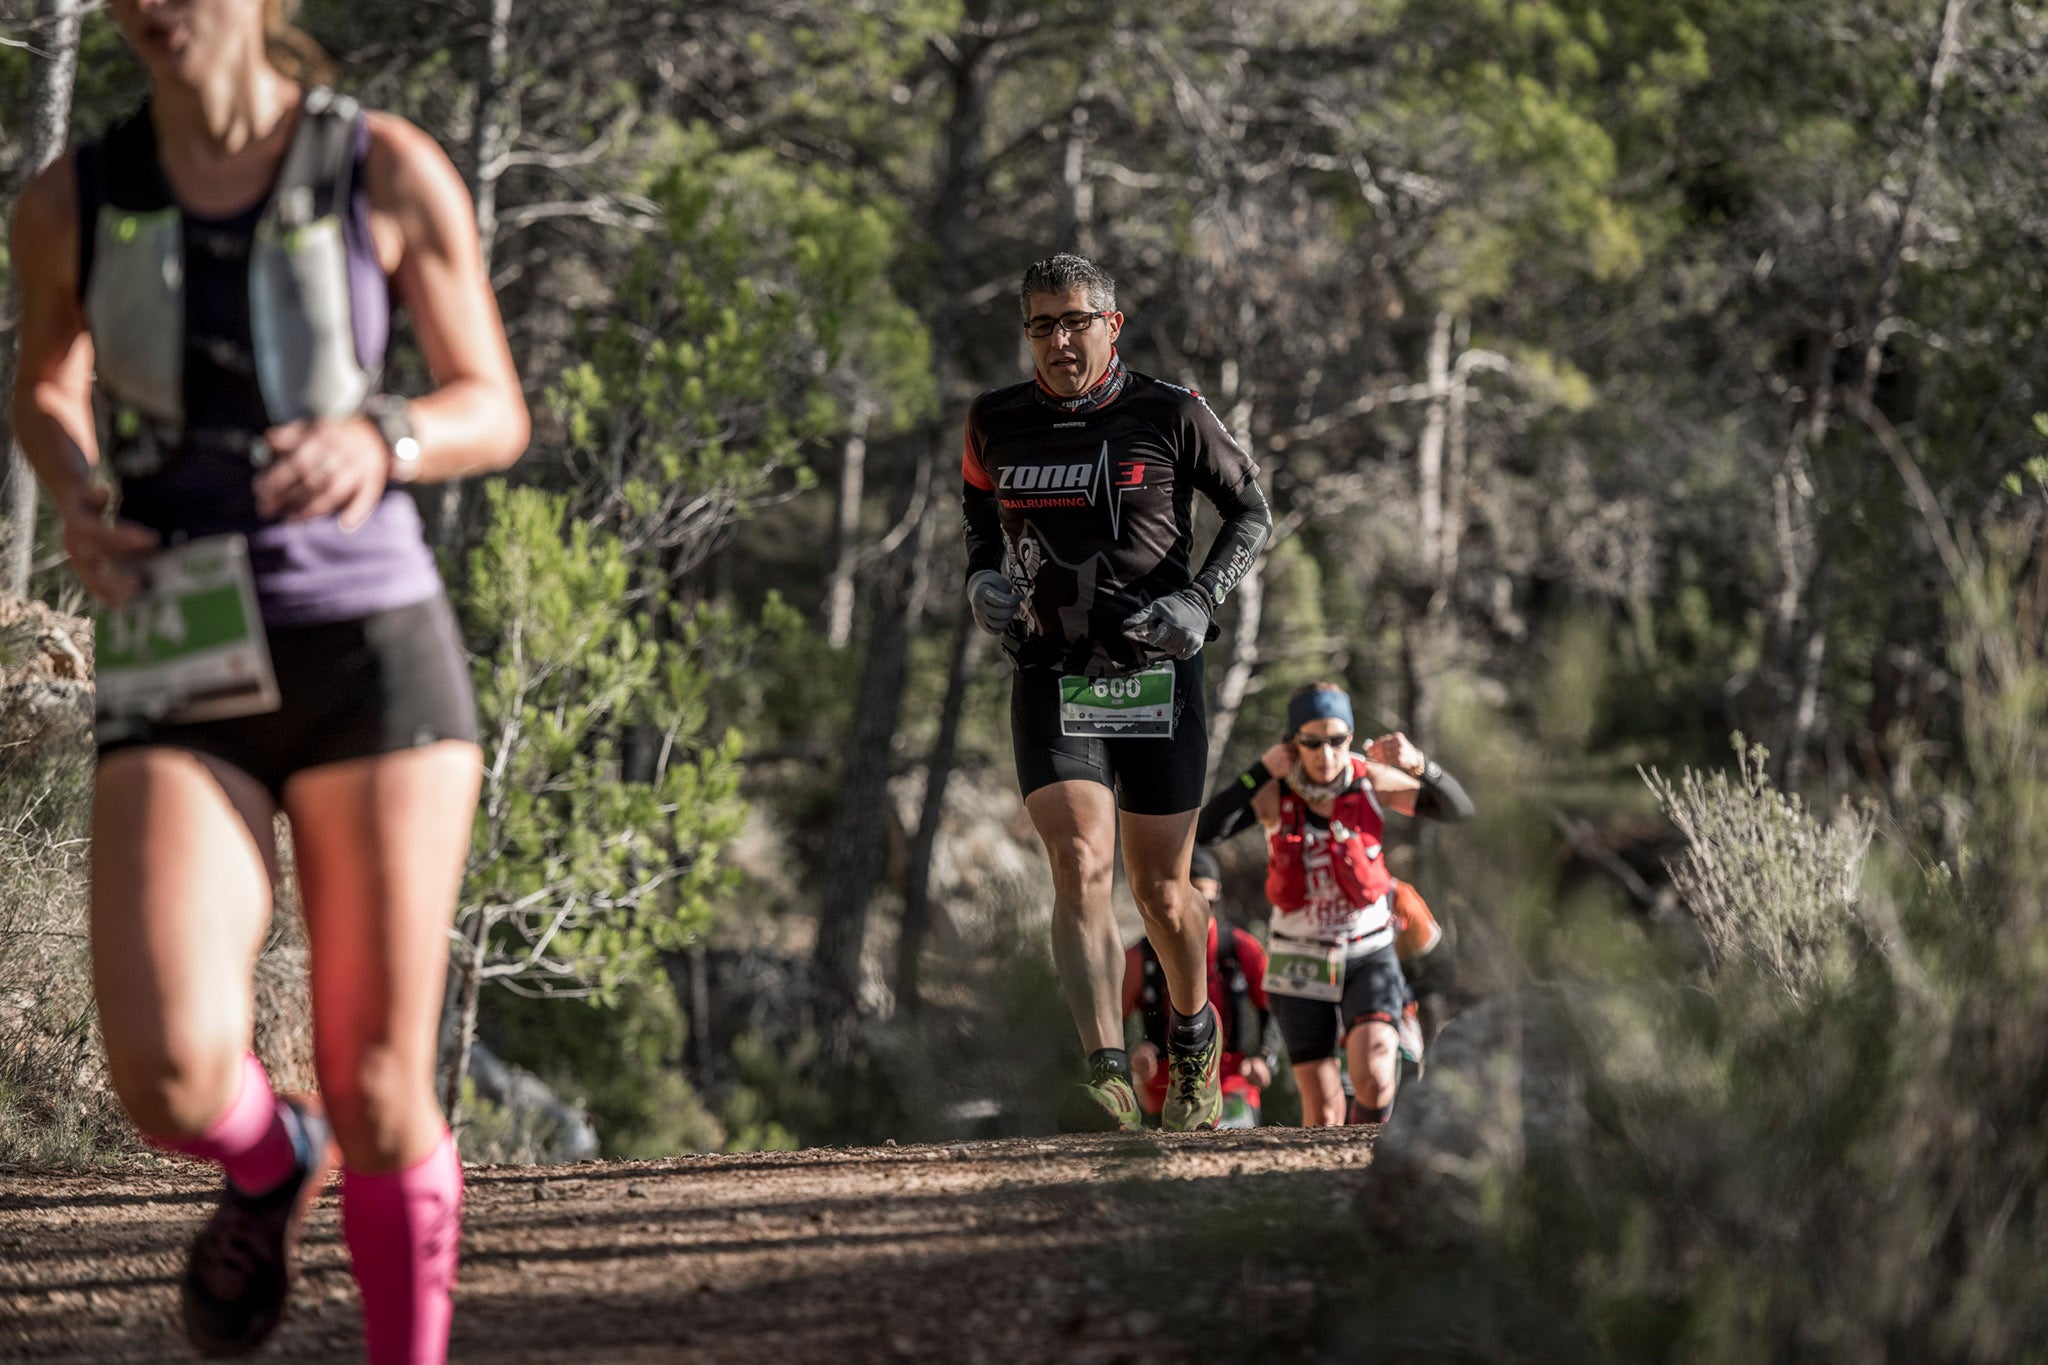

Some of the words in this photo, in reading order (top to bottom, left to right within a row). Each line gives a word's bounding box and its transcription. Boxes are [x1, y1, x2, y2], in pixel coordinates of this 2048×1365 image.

[998, 463, 1093, 489] ZONA
[1115, 461, 1146, 485] 3
[1001, 497, 1086, 509] TRAILRUNNING
[1094, 677, 1141, 698] 600
